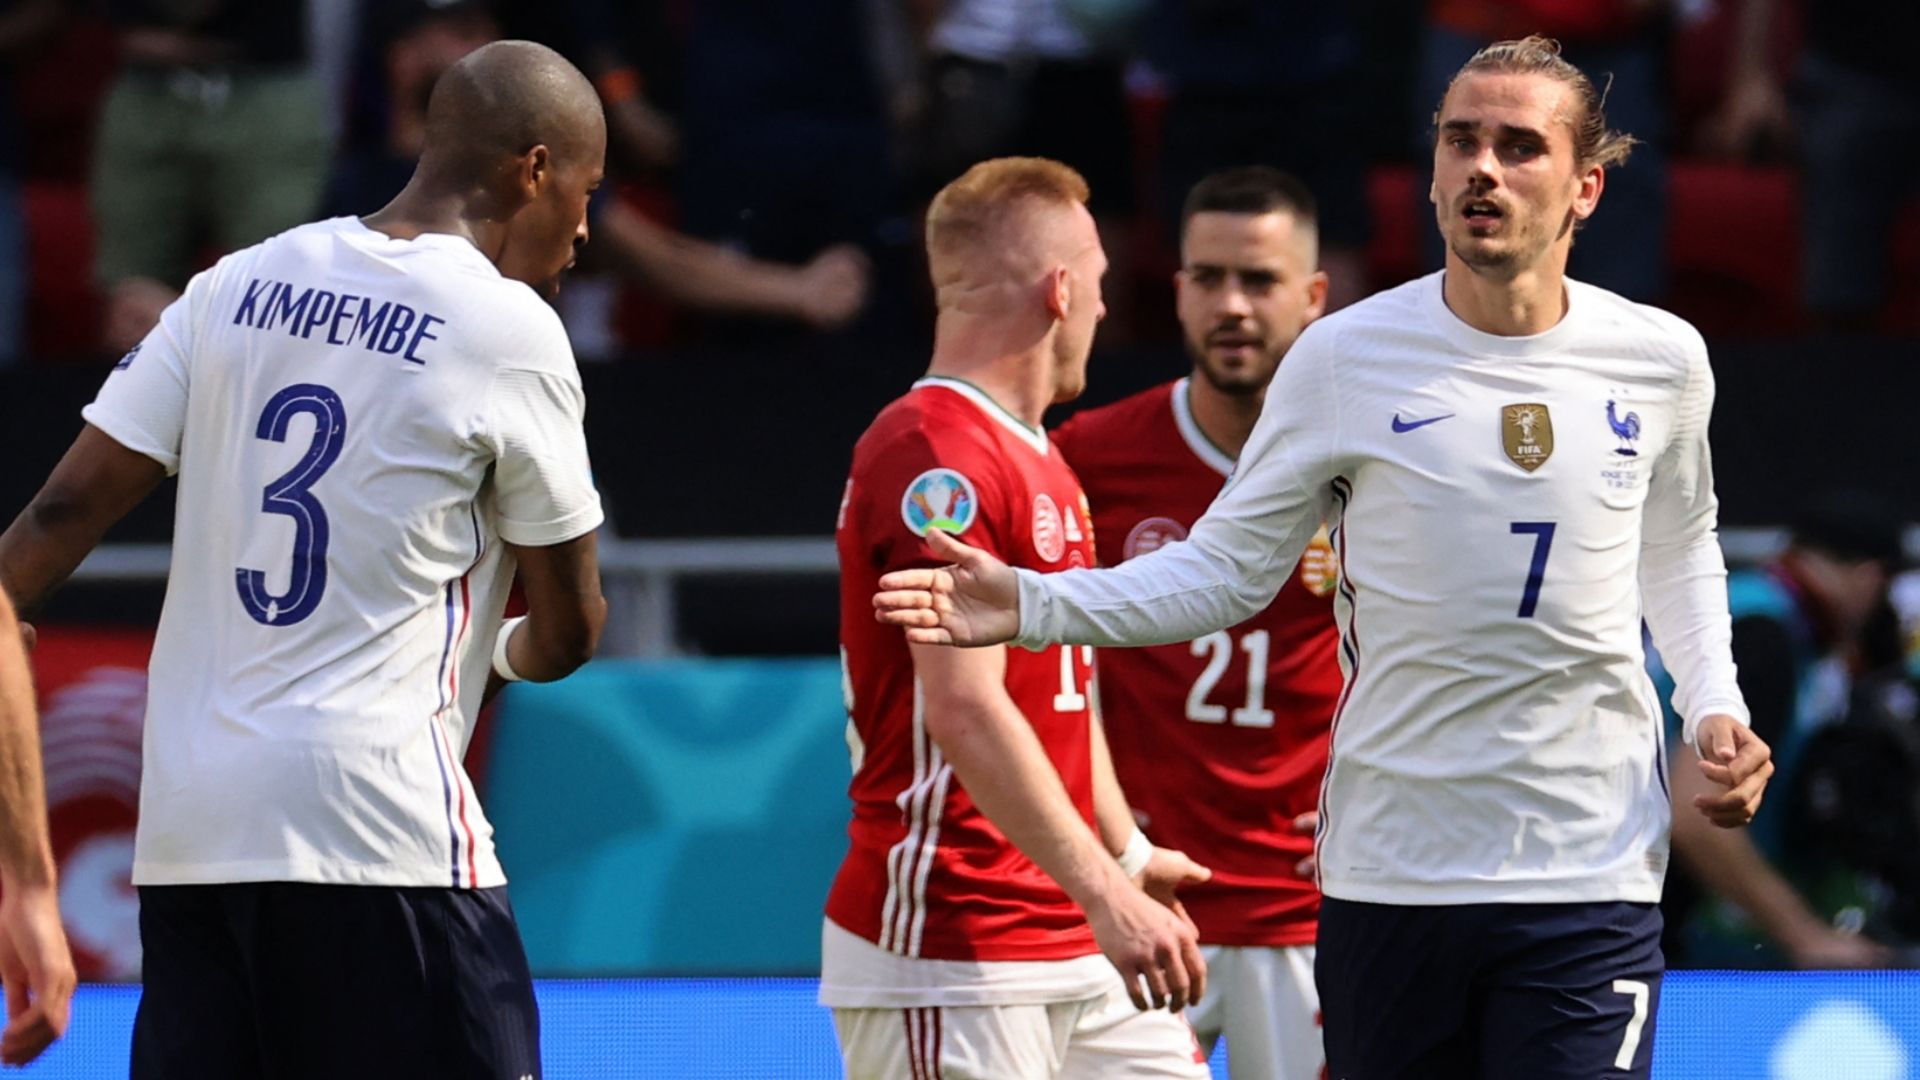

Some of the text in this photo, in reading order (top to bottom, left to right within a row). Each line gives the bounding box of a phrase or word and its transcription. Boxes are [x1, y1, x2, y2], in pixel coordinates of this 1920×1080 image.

[234, 279, 445, 365] KIMPEMBE
[1517, 445, 1542, 454] FIFA
[235, 383, 347, 627] 3
[1510, 522, 1557, 618] 7
[1185, 629, 1276, 729] 21
[1612, 979, 1650, 1071] 7
